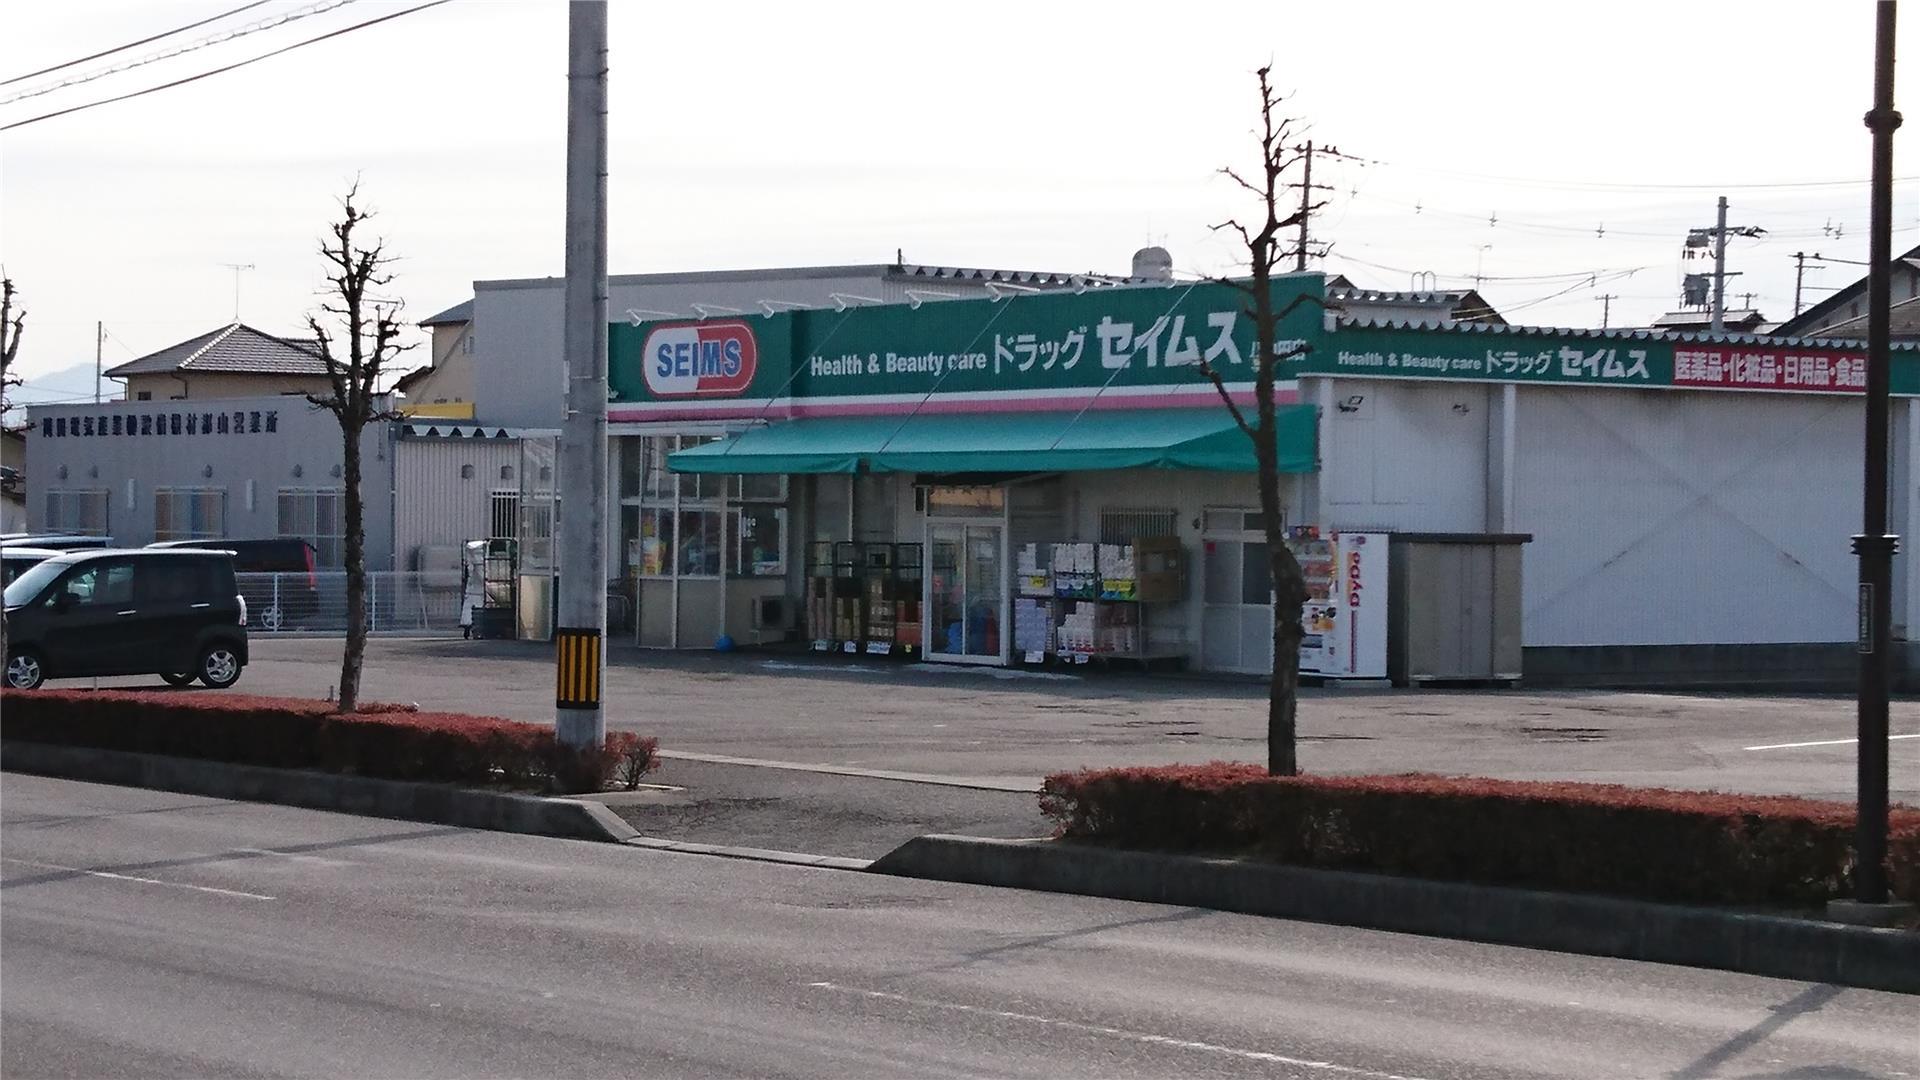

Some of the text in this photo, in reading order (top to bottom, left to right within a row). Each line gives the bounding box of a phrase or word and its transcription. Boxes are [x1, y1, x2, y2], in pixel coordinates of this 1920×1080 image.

[656, 338, 742, 378] SEIMS
[811, 354, 862, 376] Health
[867, 353, 880, 374] &
[886, 351, 944, 377] Beauty
[947, 352, 987, 370] care
[994, 325, 1088, 374] ドラッグ
[1096, 311, 1243, 369] セイムス
[1338, 346, 1650, 378] Health & Beauty care ドラッグ セイムス
